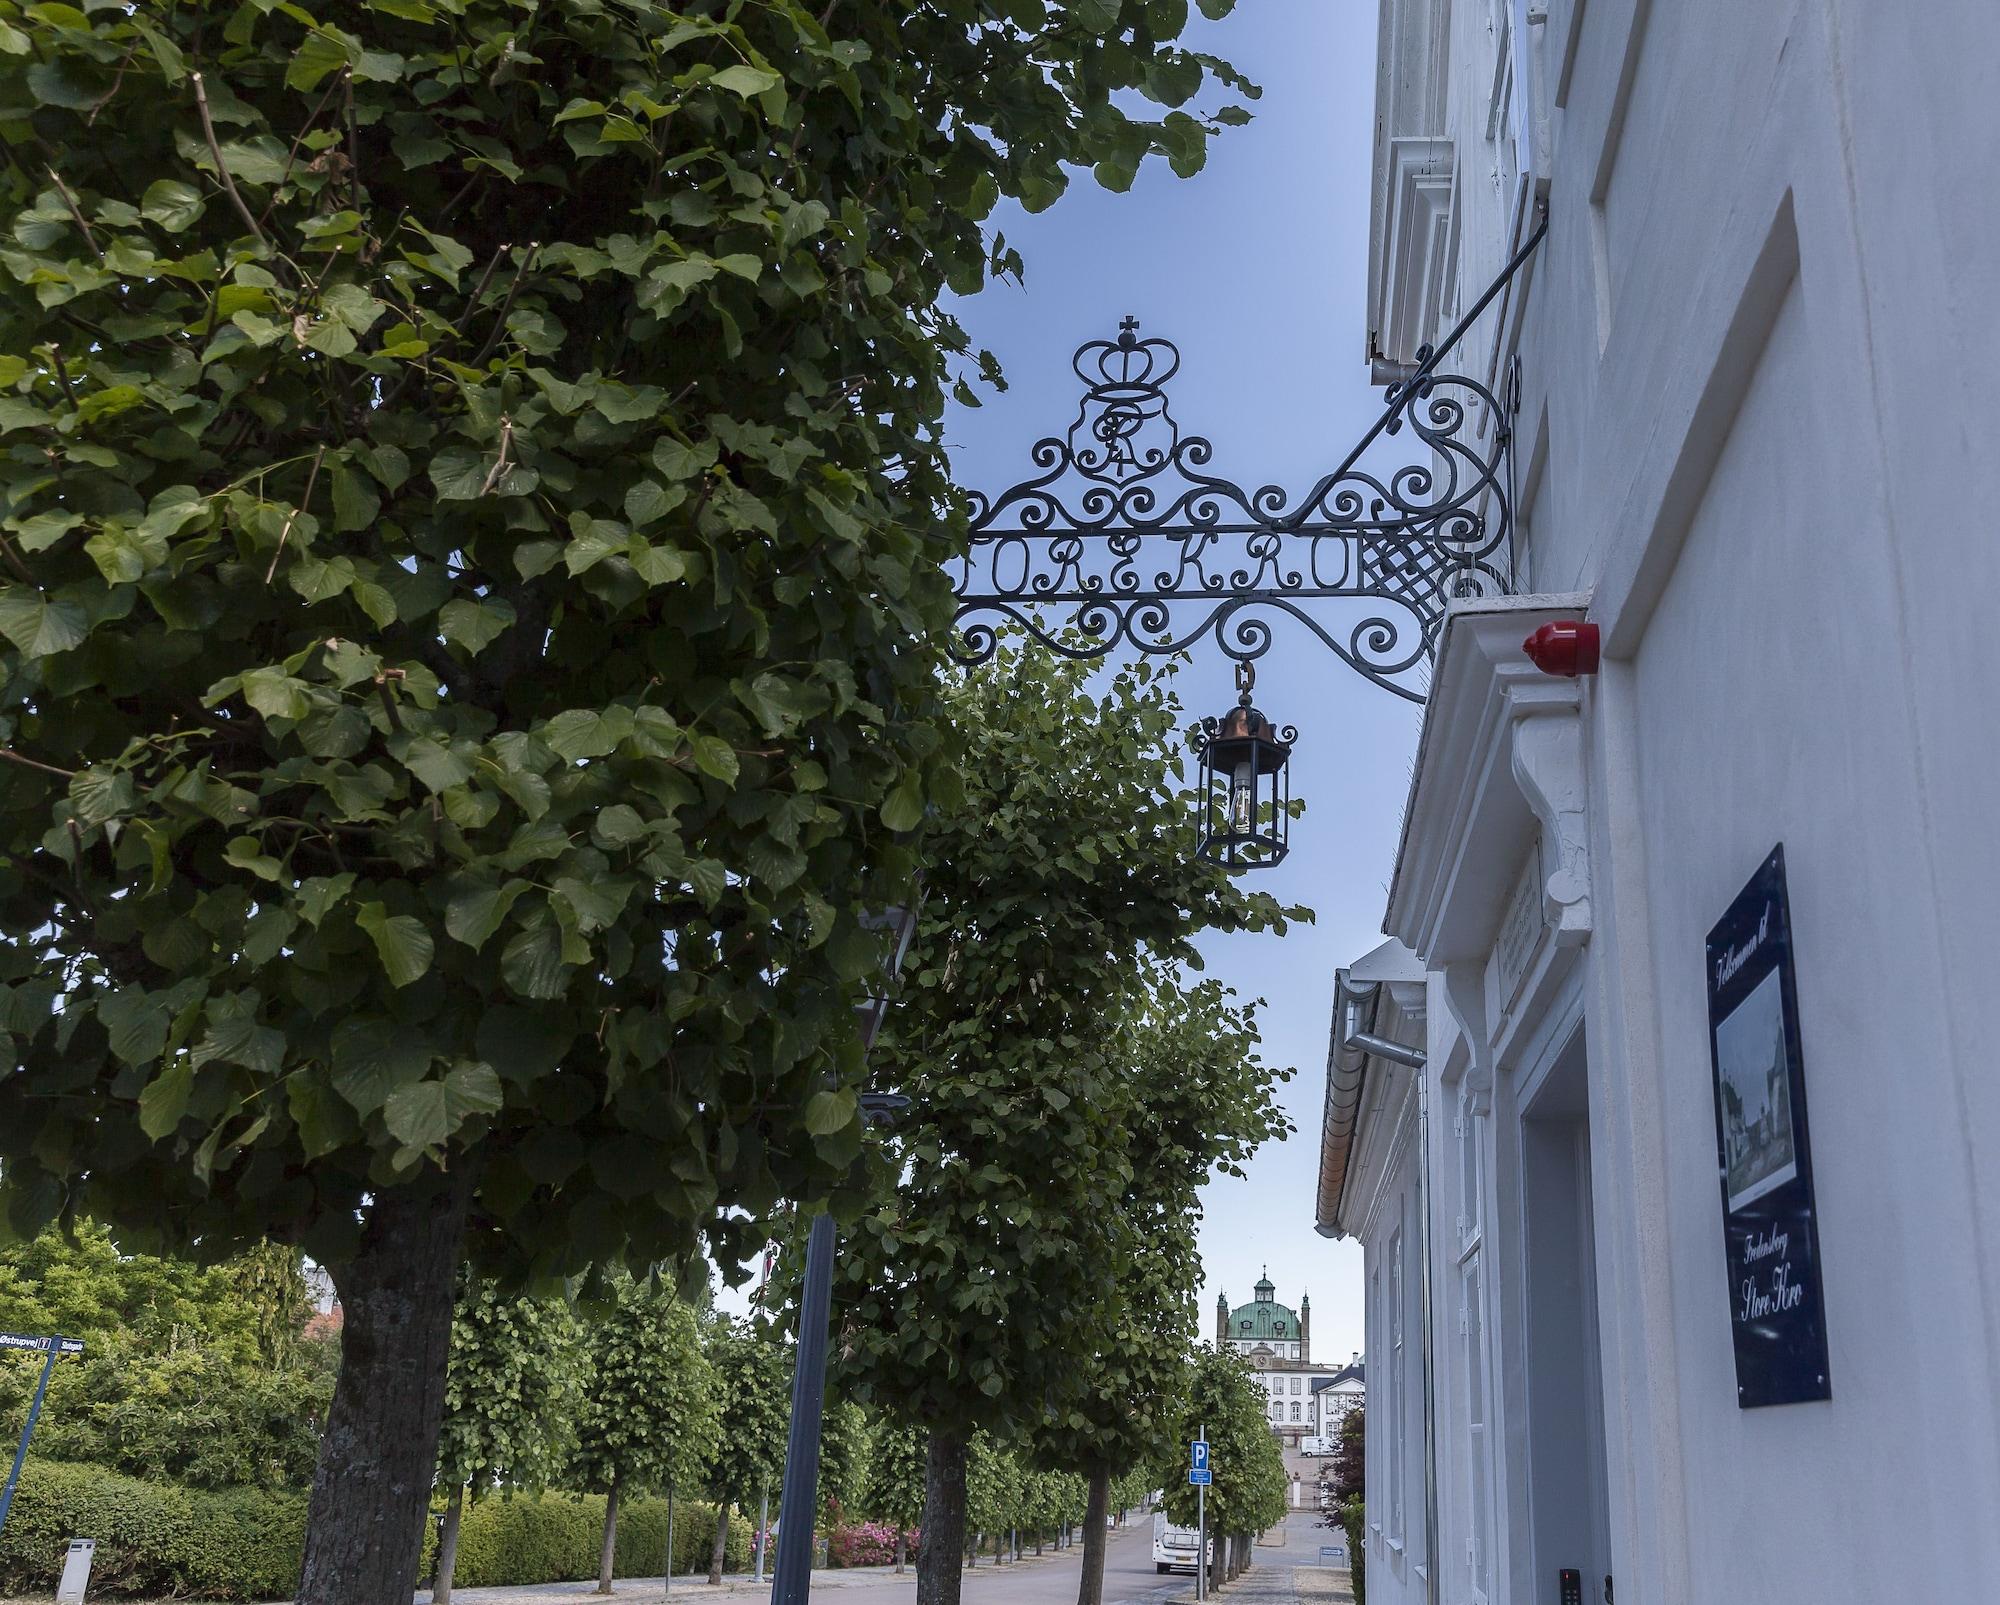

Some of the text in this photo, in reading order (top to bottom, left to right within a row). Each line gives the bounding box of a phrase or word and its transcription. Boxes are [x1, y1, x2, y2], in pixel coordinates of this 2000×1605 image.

[1154, 528, 1350, 592] KRO
[1741, 1261, 1803, 1322] Store Kro
[0, 1335, 39, 1348] Østrupvej
[1195, 1444, 1206, 1467] P
